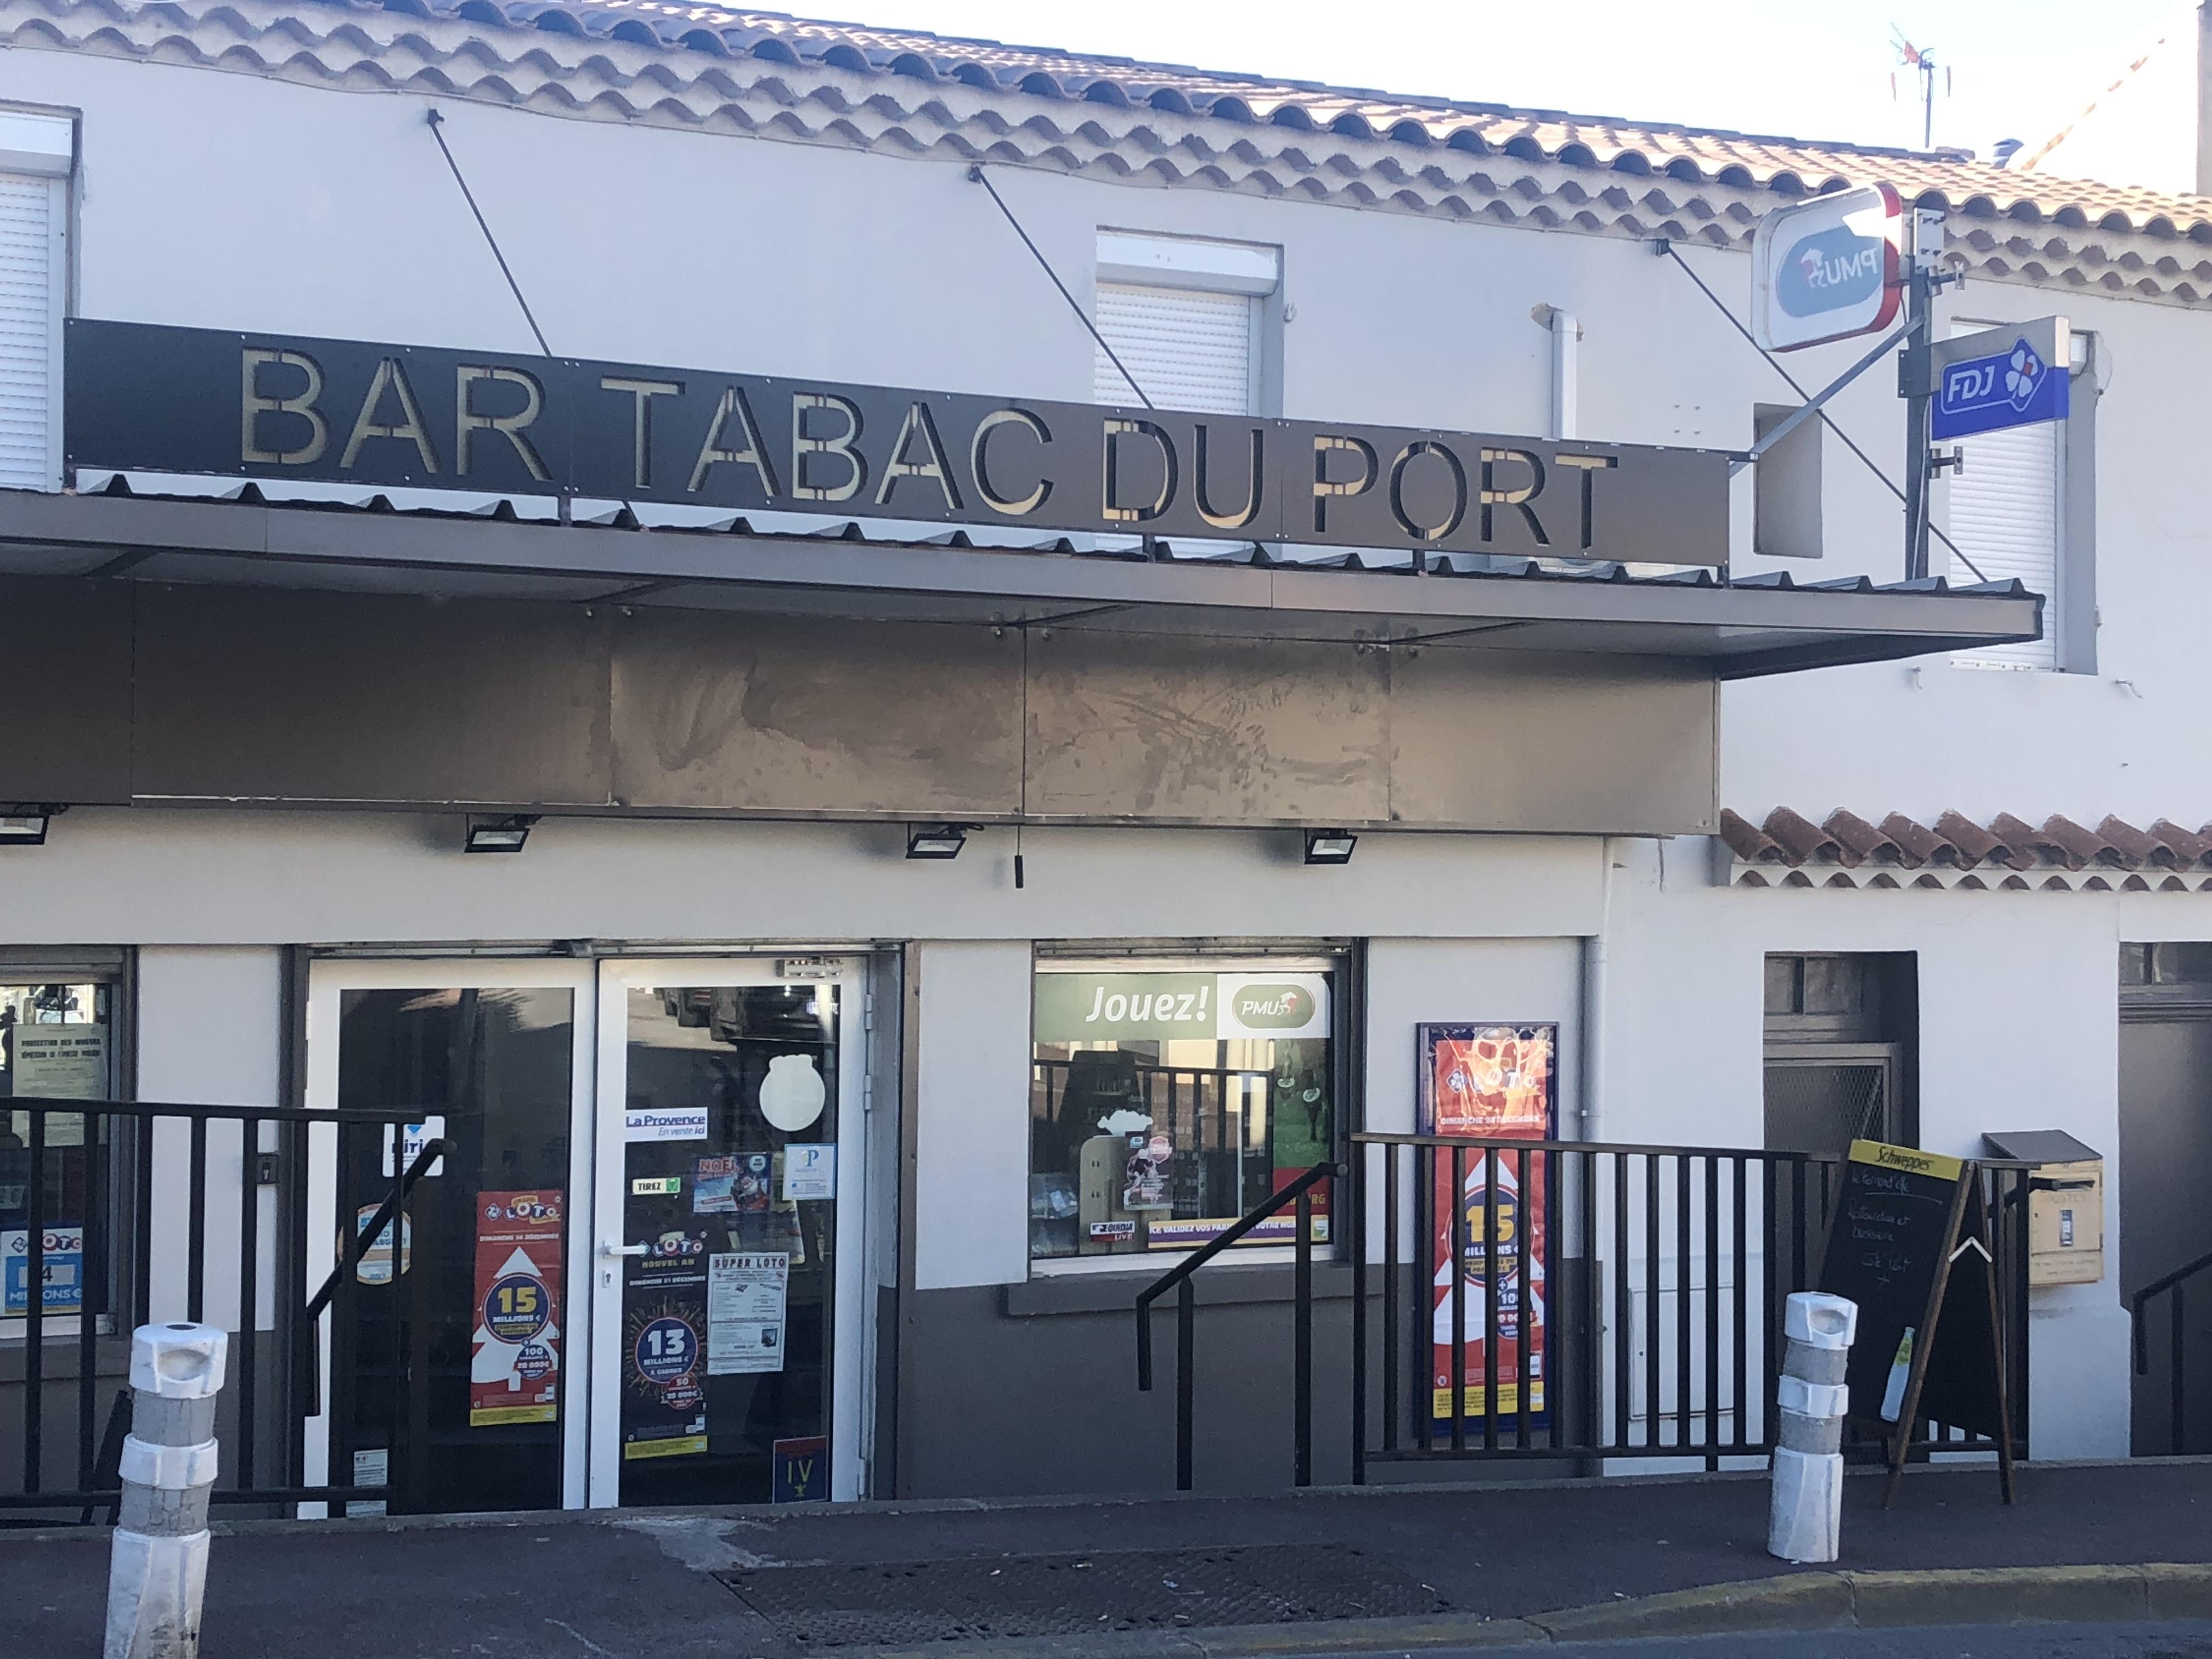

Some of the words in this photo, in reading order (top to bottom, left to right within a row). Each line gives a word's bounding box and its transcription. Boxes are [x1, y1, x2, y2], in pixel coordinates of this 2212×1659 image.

[1948, 365, 1994, 403] FDJ
[242, 346, 554, 482] BAR
[601, 375, 1053, 516] TABAC
[1102, 417, 1263, 529] DU
[1313, 434, 1618, 548] PORT
[1086, 986, 1209, 1022] Jouez!
[1241, 1000, 1279, 1016] PMU
[626, 1116, 642, 1127] La
[644, 1115, 706, 1126] Provence
[658, 1127, 669, 1136] En
[695, 1126, 705, 1135] ici
[1875, 1146, 1934, 1171] Schweppes
[638, 1182, 661, 1191] TIREZ
[504, 1202, 556, 1220] LOTO
[1465, 1204, 1514, 1243] 15
[42, 1233, 81, 1251] OTO
[652, 1238, 703, 1257] LOTO
[1465, 1245, 1512, 1256] MILLNS
[642, 1260, 678, 1268] NOUVEL
[714, 1259, 751, 1269] SUPER
[757, 1257, 785, 1268] LOTO
[498, 1286, 537, 1313] 15
[1501, 1293, 1519, 1305] 10
[648, 1328, 685, 1356] 13
[644, 1356, 682, 1365] MILLIONS
[676, 1378, 689, 1386] 50
[787, 1459, 813, 1484] IV
